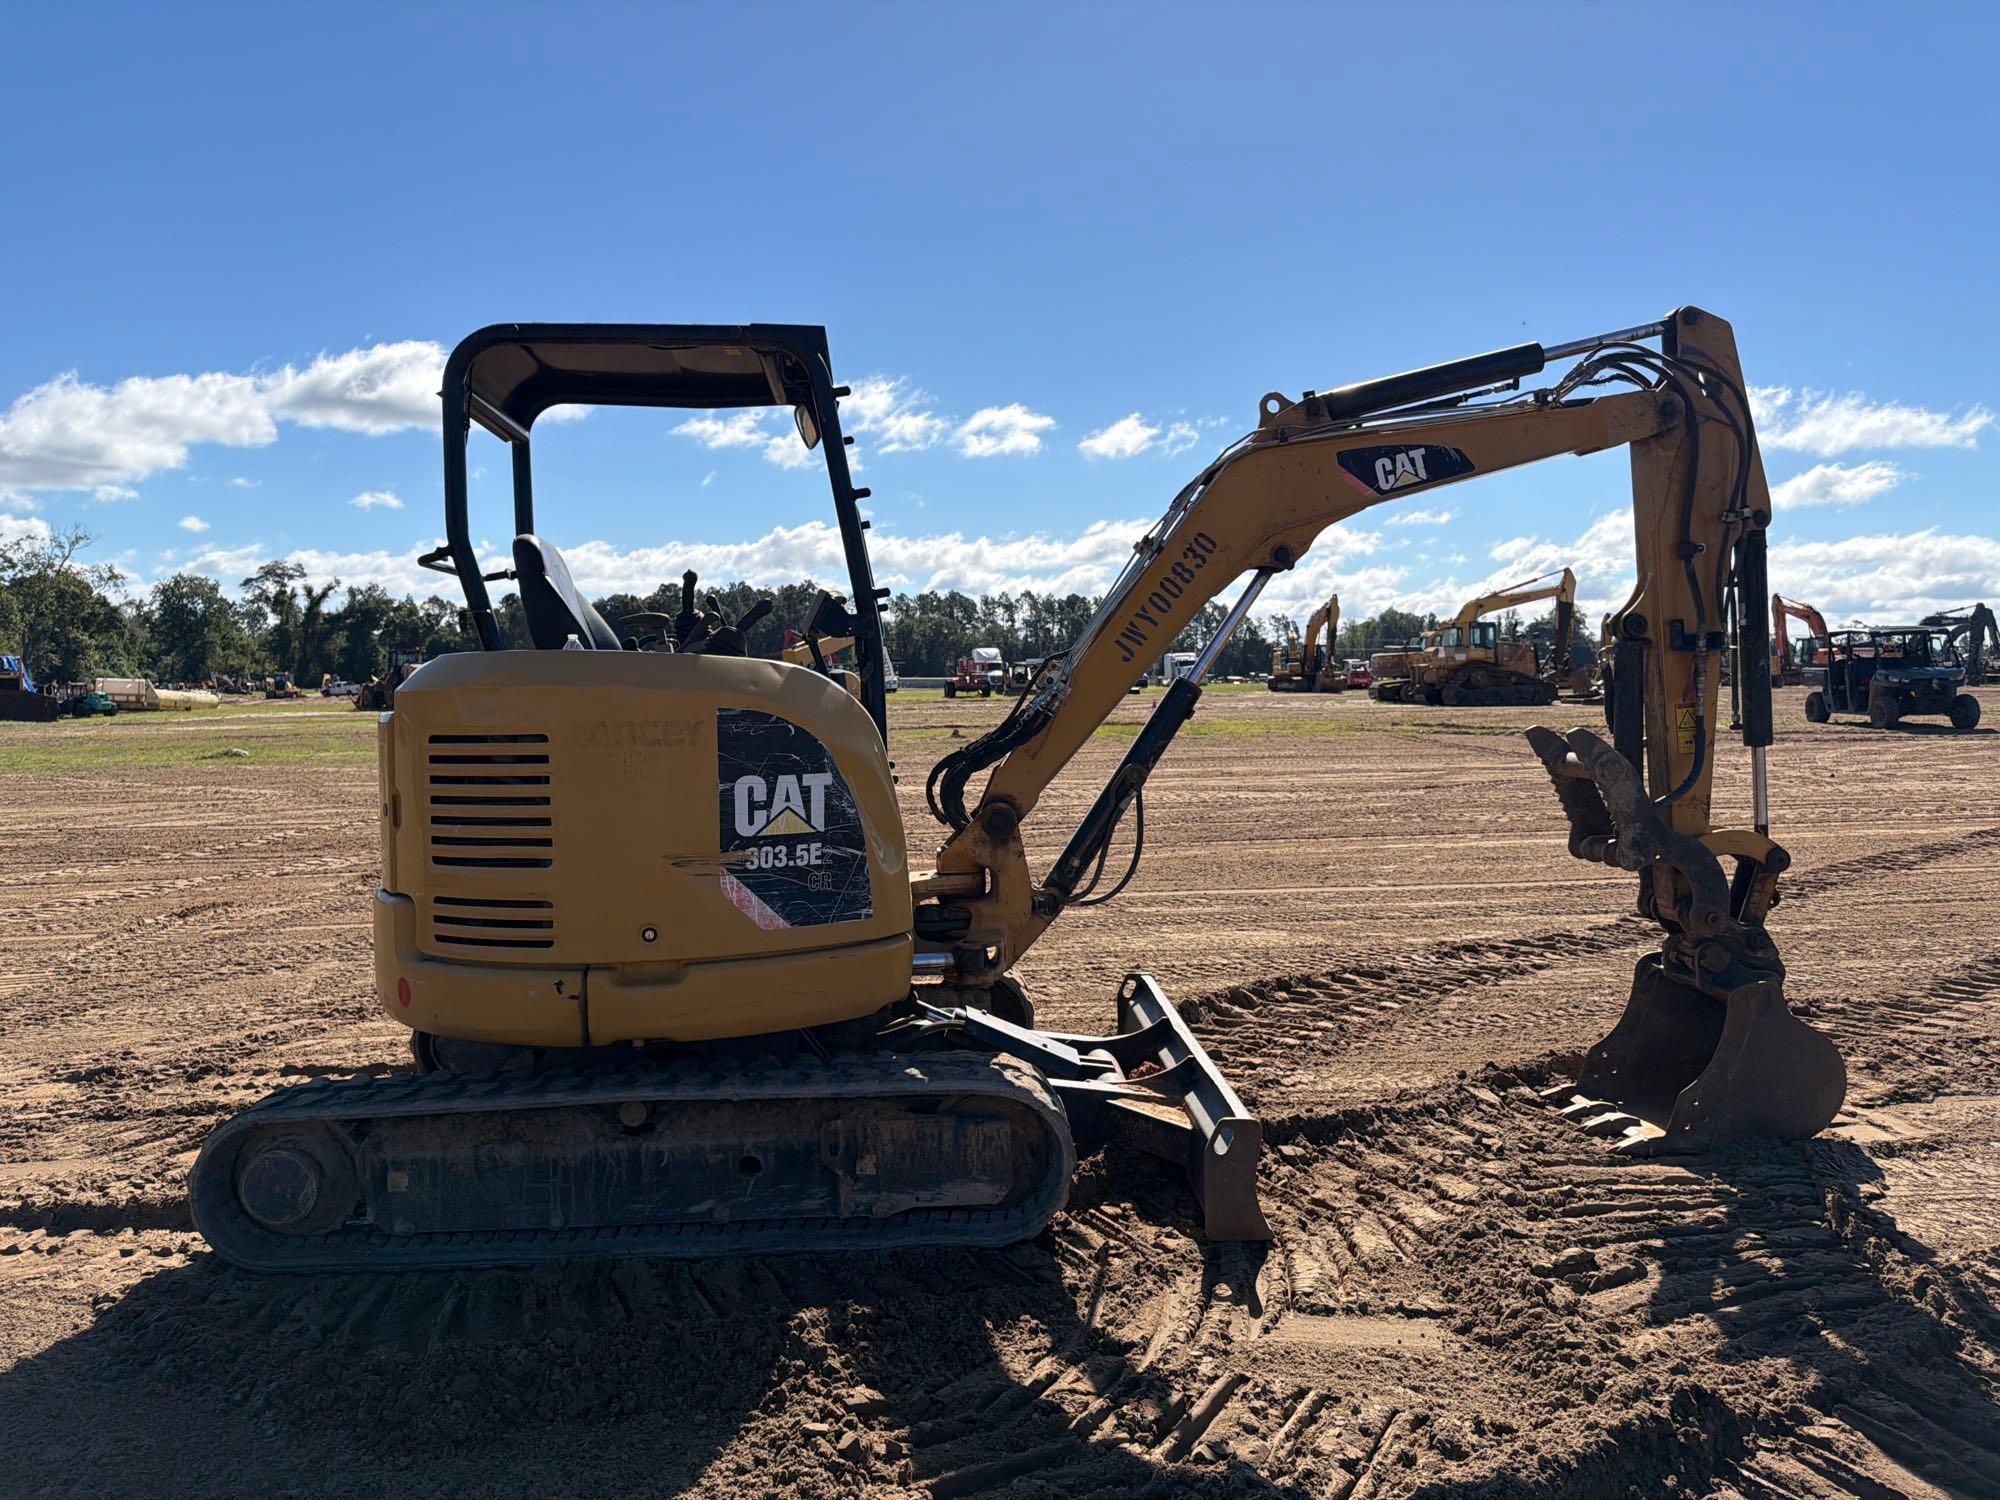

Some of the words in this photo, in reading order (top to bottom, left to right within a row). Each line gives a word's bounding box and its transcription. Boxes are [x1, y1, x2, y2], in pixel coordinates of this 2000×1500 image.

[1375, 447, 1427, 490] CAT
[1114, 531, 1217, 663] JWY00830
[734, 772, 833, 837] CAT
[807, 871, 833, 892] CR
